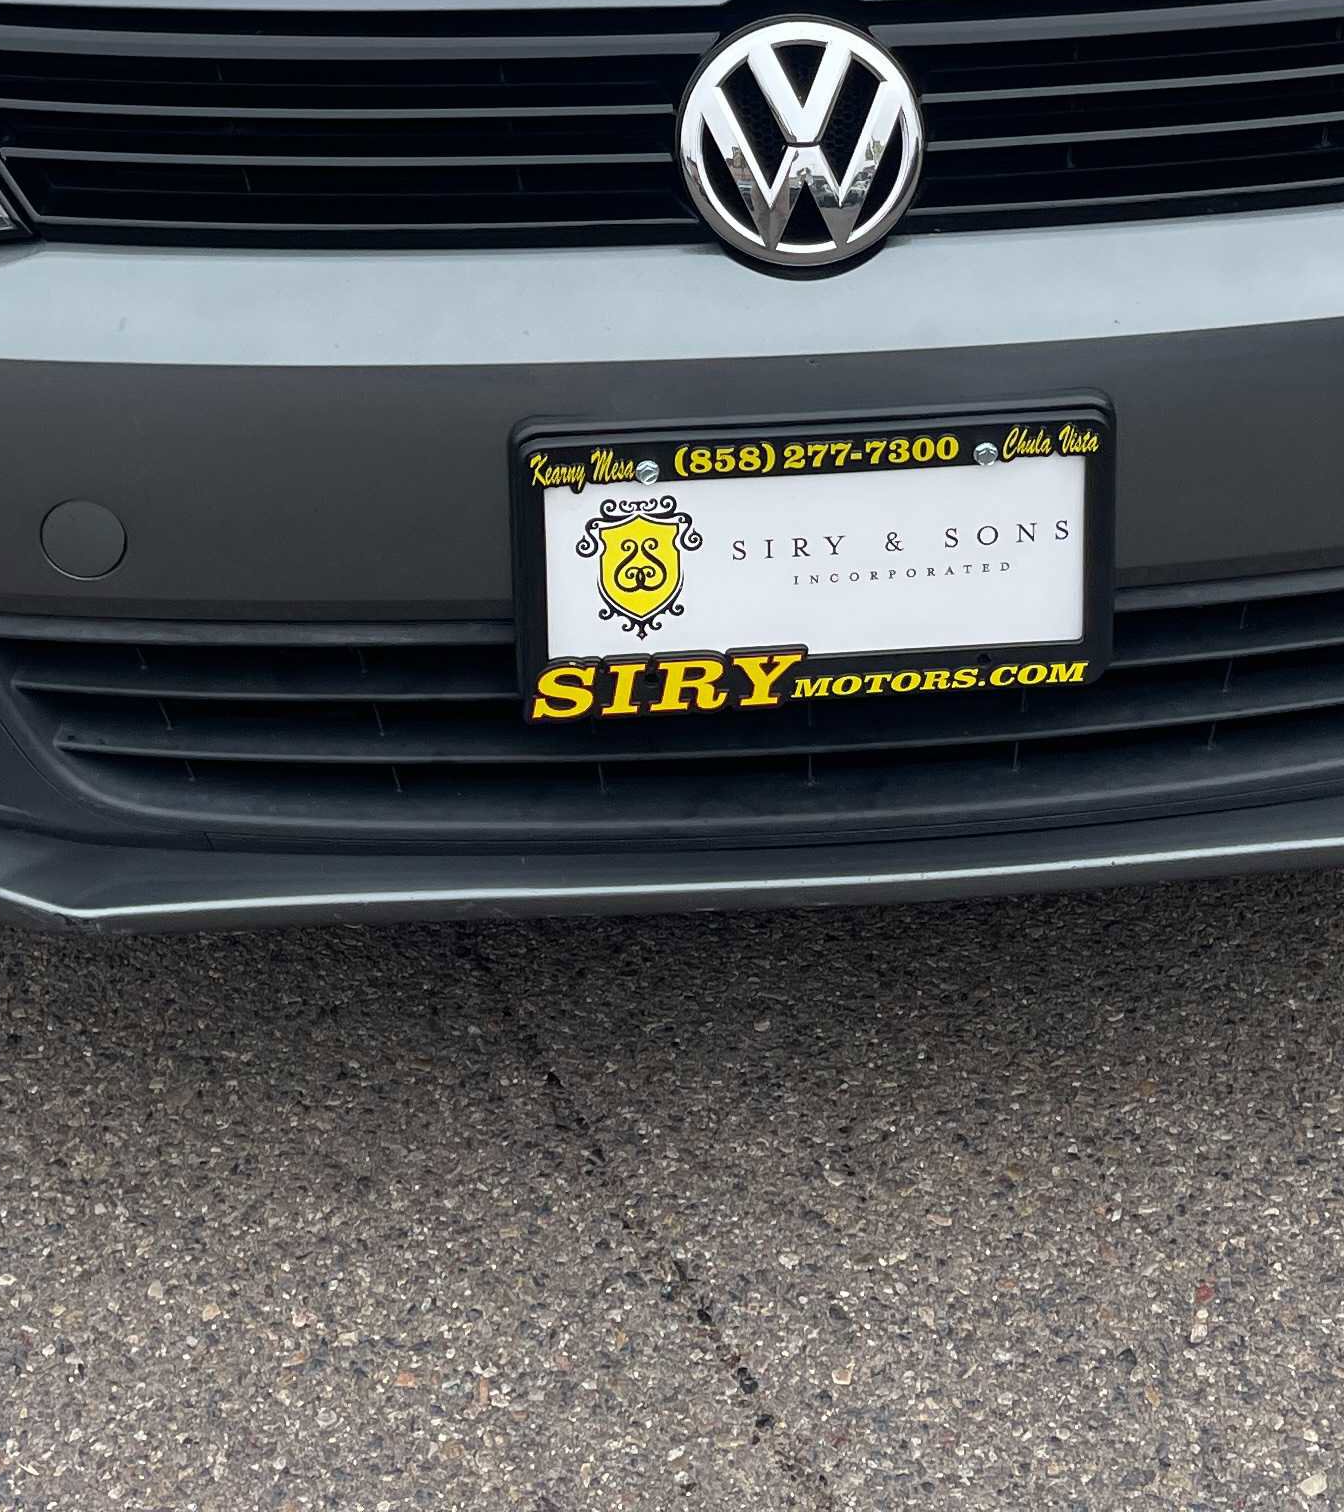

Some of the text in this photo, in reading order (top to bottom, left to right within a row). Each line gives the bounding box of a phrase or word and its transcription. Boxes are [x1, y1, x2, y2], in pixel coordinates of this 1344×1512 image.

[674, 435, 959, 477] (858) 277-7300
[1003, 424, 1100, 460] Chula Vista
[530, 449, 636, 489] Kearny Mesa
[732, 519, 1070, 561] SIRY & SONS
[794, 561, 1012, 585] INCORPORATED
[531, 651, 1088, 720] SIRY MOTORS.COM
